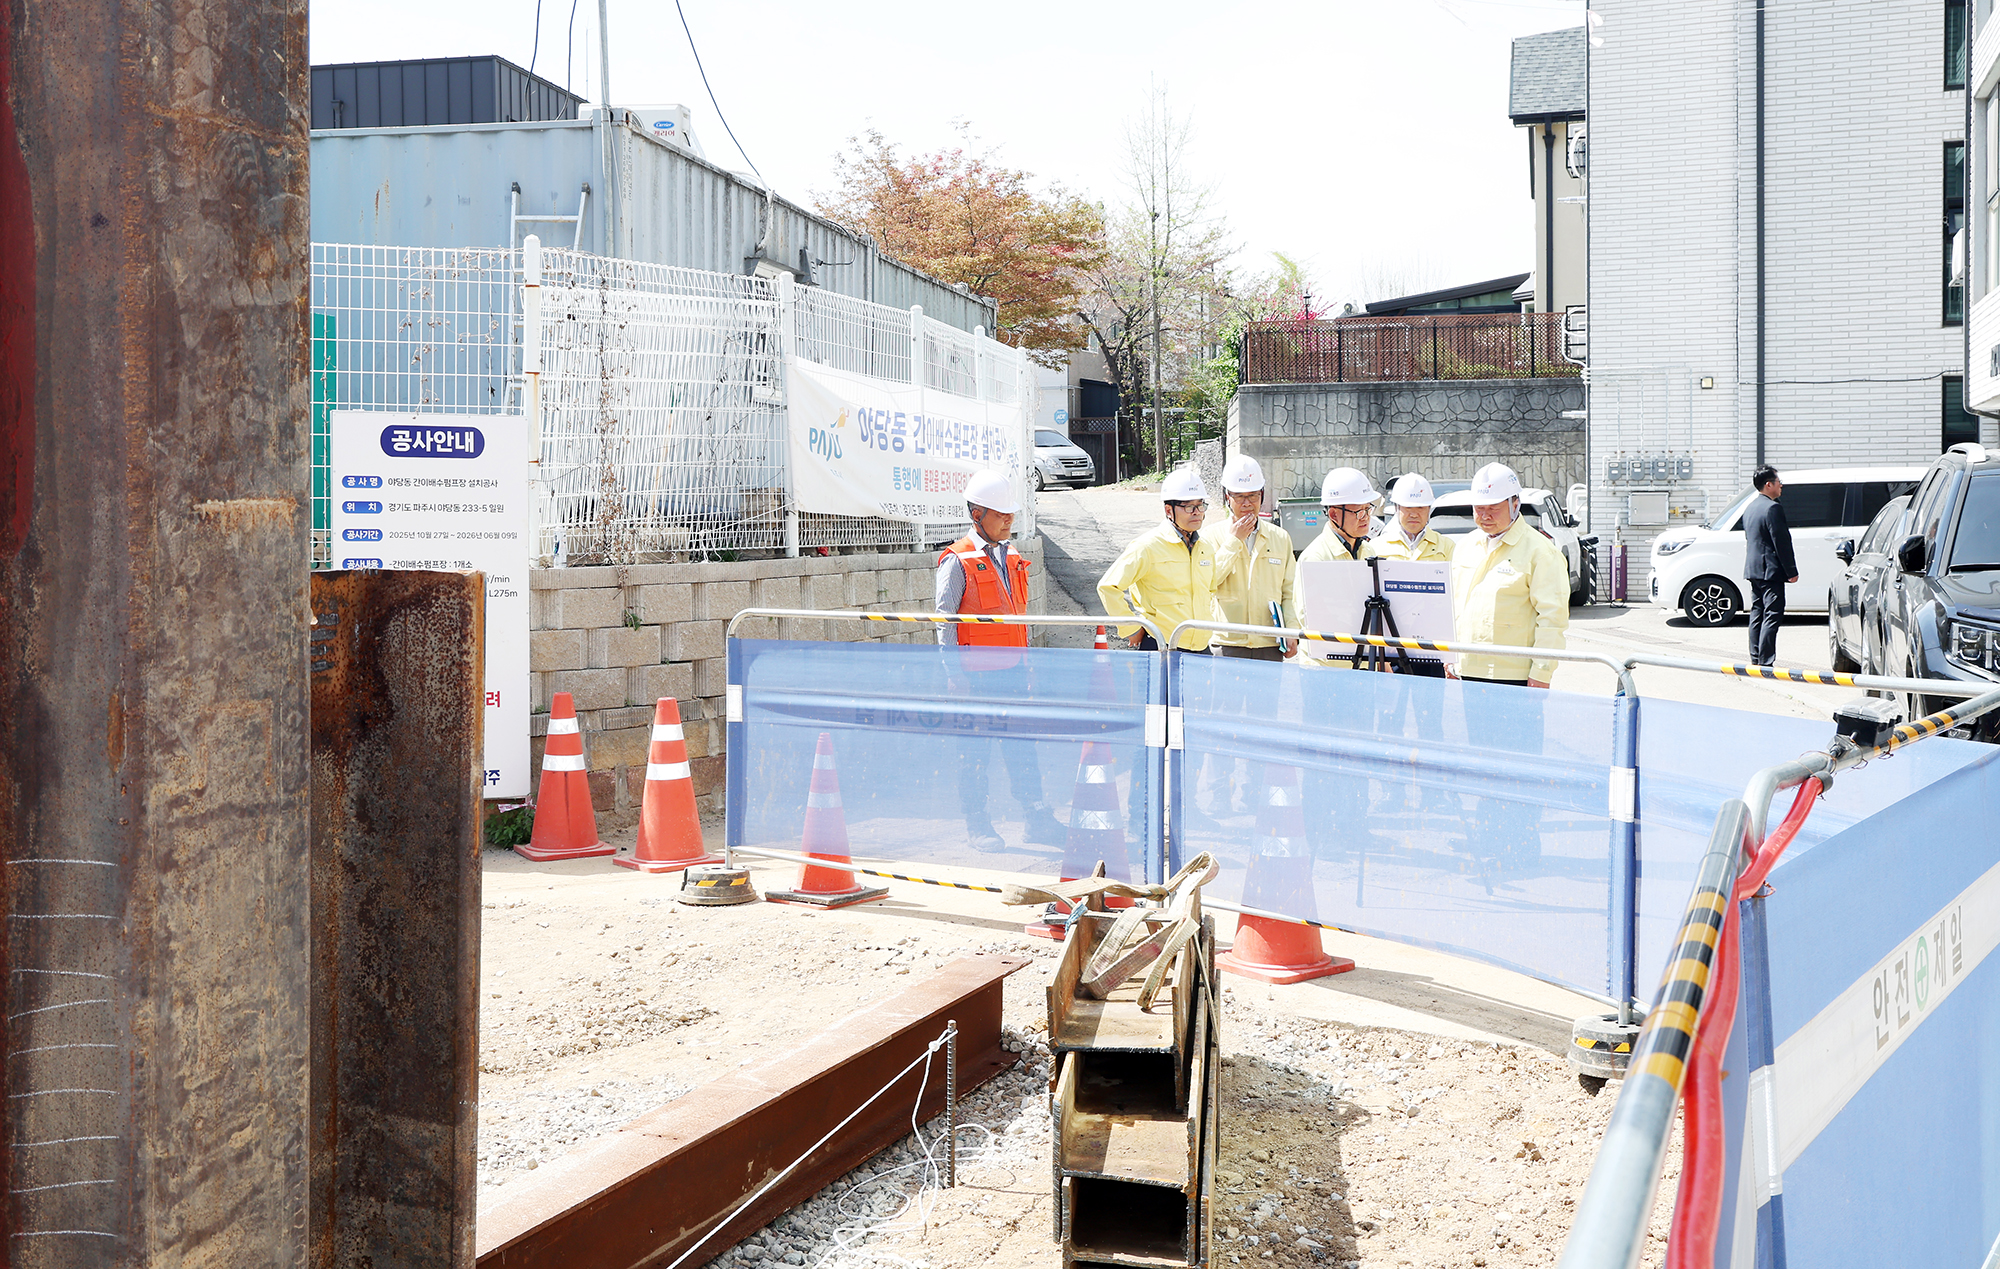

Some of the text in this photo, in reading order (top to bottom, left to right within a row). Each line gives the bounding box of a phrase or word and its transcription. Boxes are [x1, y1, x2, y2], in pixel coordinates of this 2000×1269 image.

[391, 430, 475, 453] 공사안내
[858, 407, 907, 453] 야당동
[913, 414, 978, 461] 간이배수펌프장
[809, 427, 843, 462] PAJU
[387, 477, 411, 487] 야당동
[468, 479, 499, 488] 설치공사
[893, 467, 921, 491] 통행에
[924, 469, 939, 492] 불편을
[941, 471, 952, 493] 드려
[388, 503, 411, 512] 경기도
[413, 504, 437, 513] 파주시
[437, 504, 460, 513] 야당동
[462, 504, 488, 513] 233-5
[488, 504, 504, 513] 일원
[346, 530, 379, 540] 공사기간
[389, 531, 415, 539] 2025년
[417, 531, 431, 539] 10월
[433, 531, 449, 539] 27일
[456, 531, 482, 540] 2026년
[483, 531, 500, 540] 06월
[501, 531, 518, 539] 09일
[346, 559, 379, 569] 공사내용
[453, 560, 473, 569] 1개소
[489, 590, 518, 598] L275m
[1873, 905, 1963, 1052] 안전 제일
